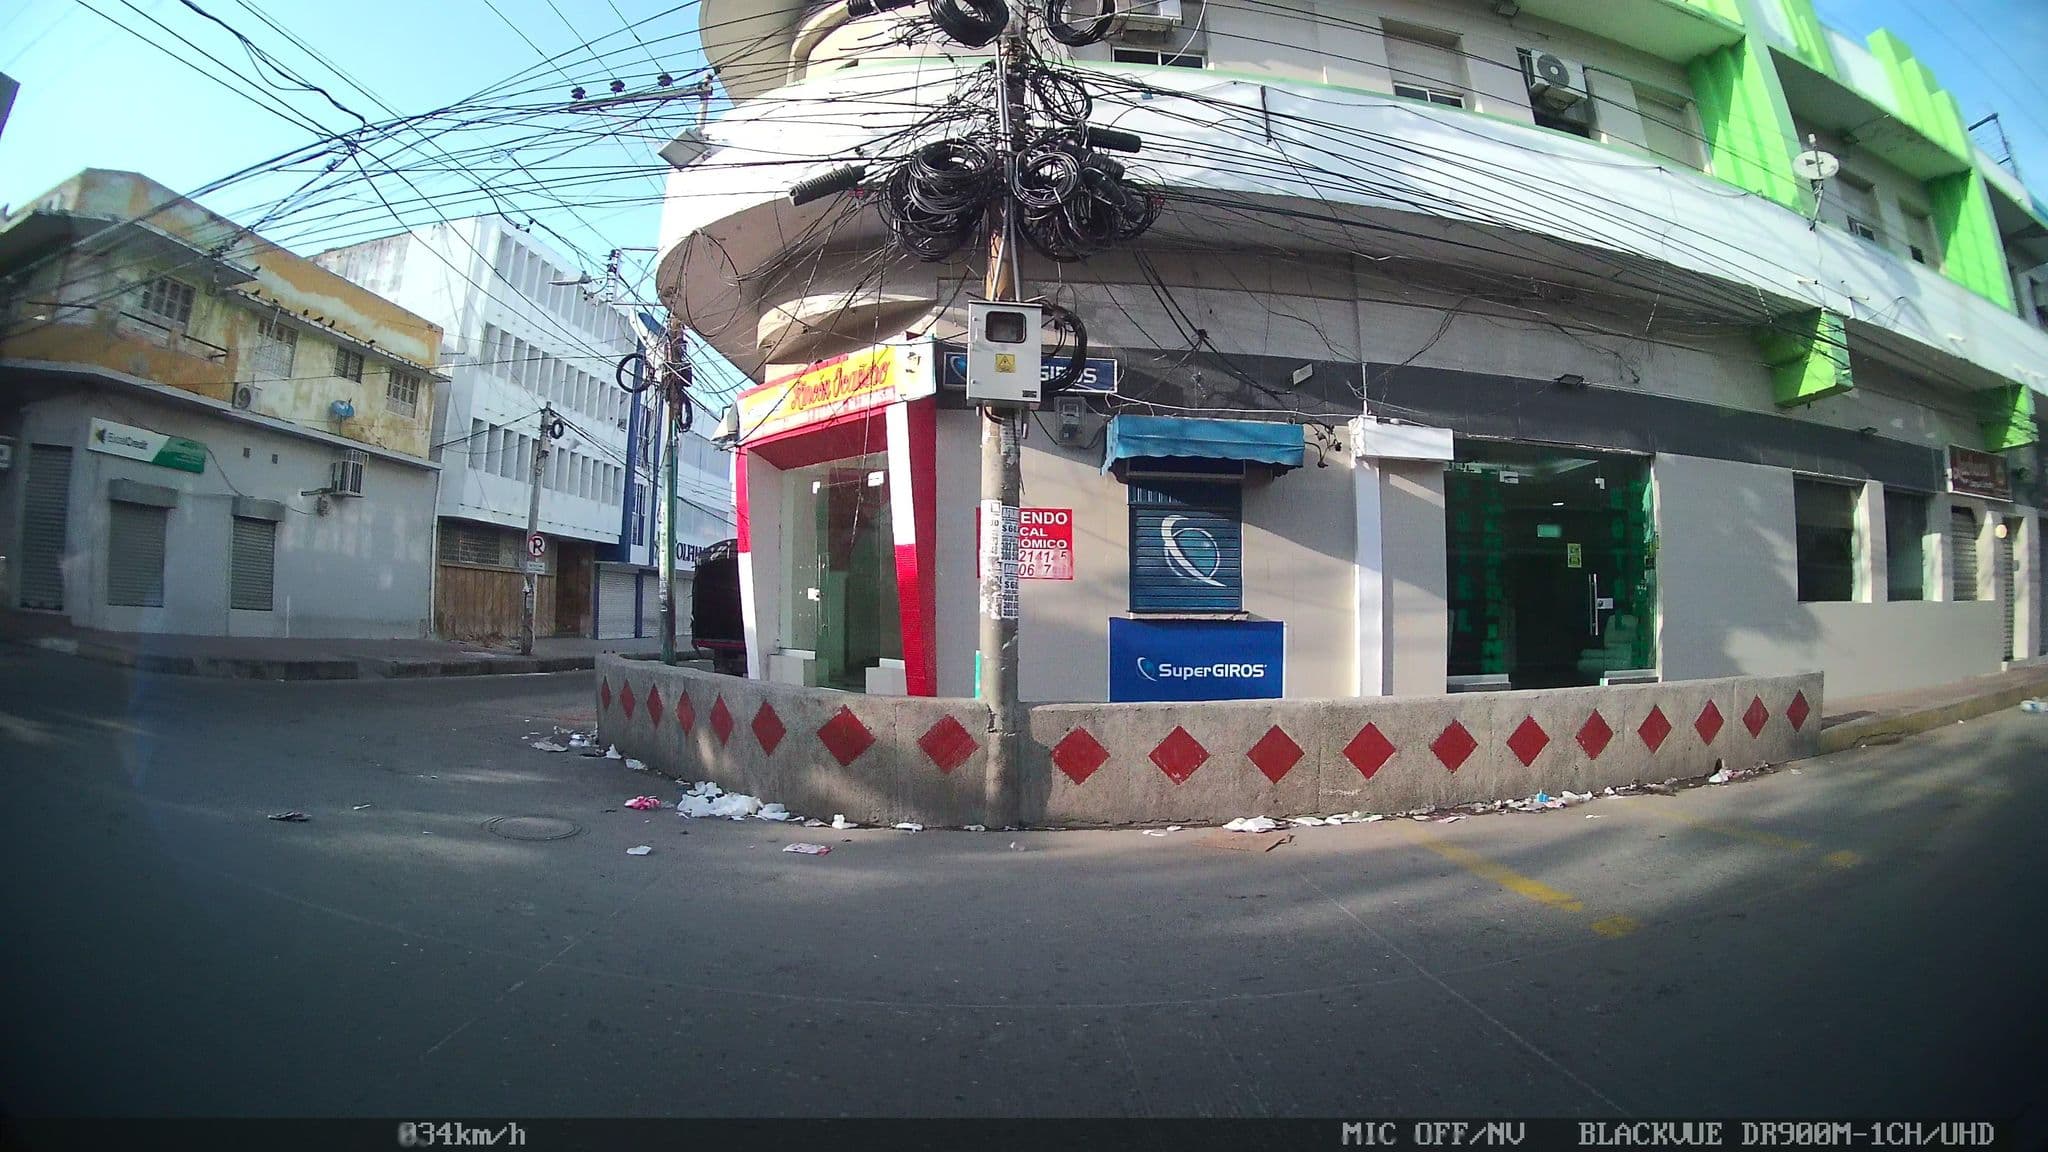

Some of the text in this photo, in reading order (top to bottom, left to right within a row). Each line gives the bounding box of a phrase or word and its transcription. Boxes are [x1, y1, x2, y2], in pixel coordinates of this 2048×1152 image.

[1020, 511, 1068, 525] ENDO
[1019, 527, 1048, 537] CAL
[1159, 663, 1266, 681] SuperGIROS
